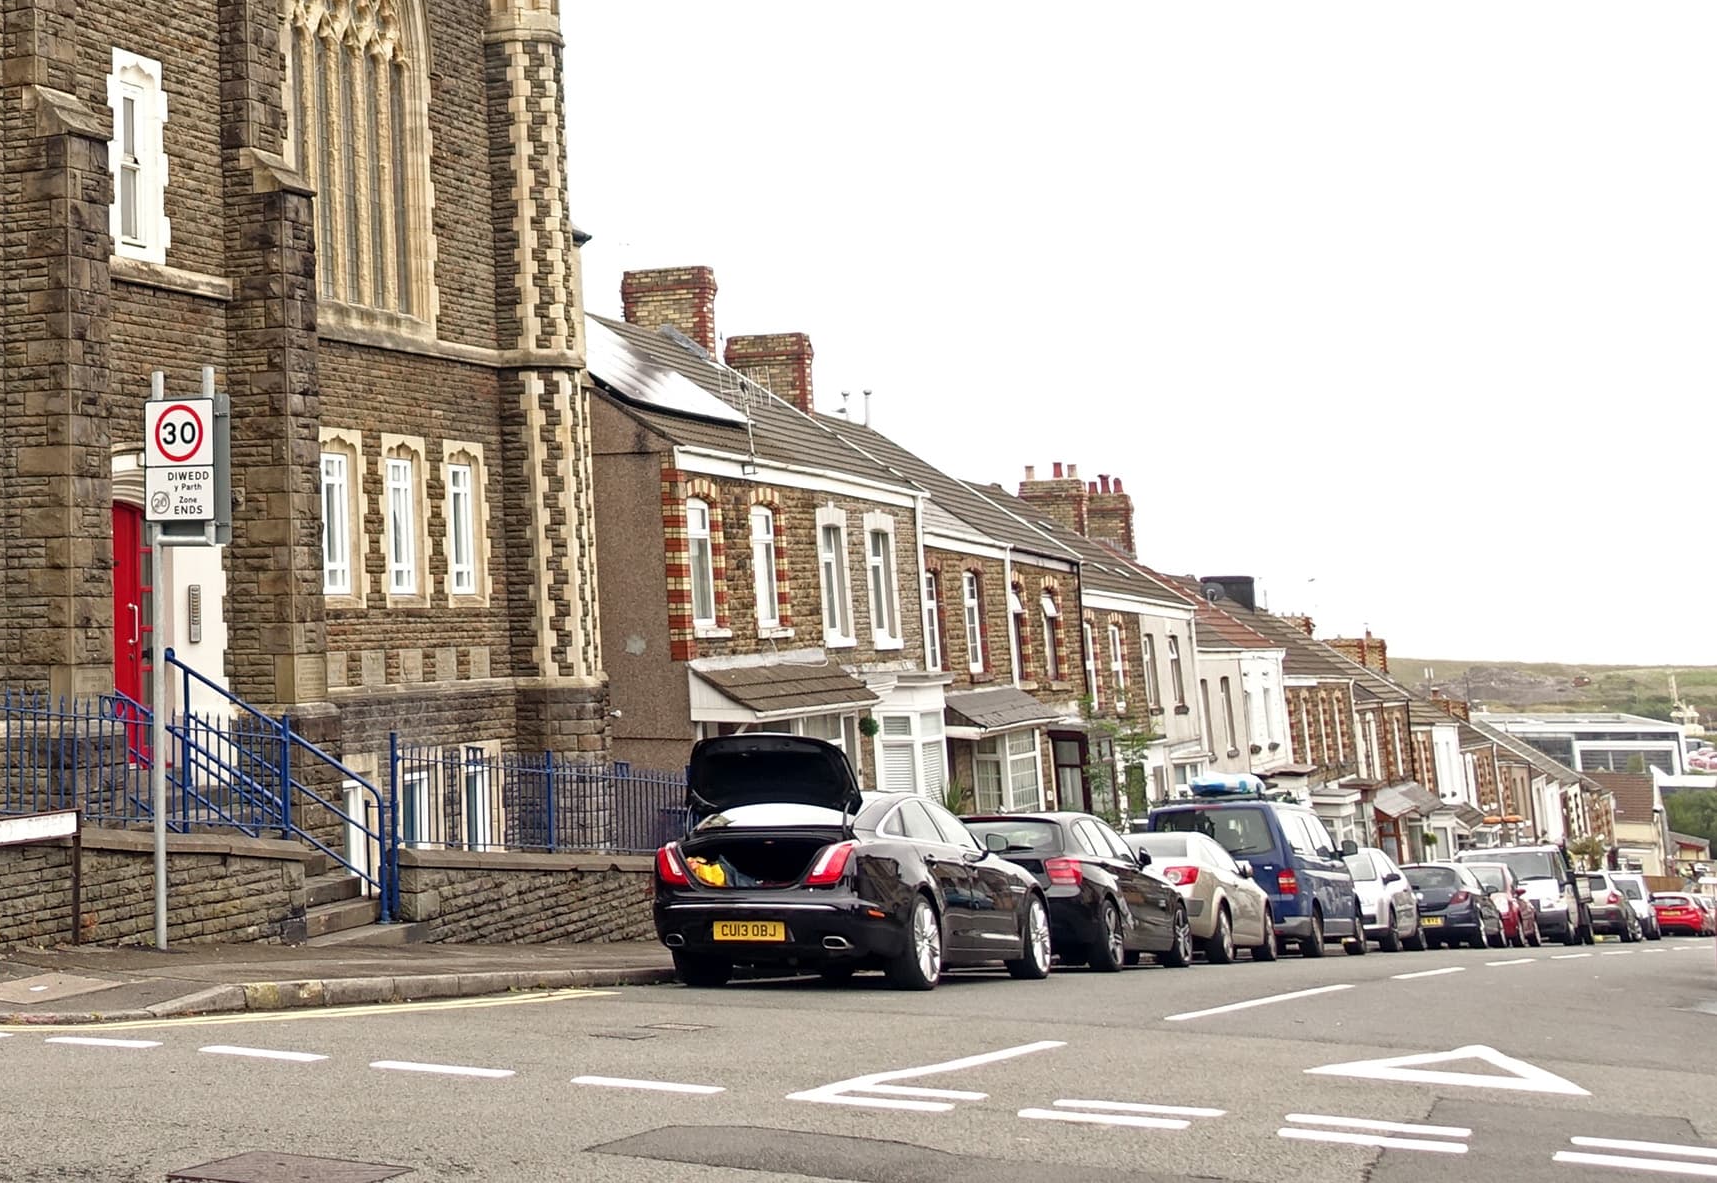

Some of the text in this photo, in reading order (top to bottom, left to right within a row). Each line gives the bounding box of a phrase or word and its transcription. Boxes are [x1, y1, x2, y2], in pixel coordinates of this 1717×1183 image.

[162, 421, 196, 445] 30
[167, 471, 209, 481] DIWEDD
[181, 483, 202, 491] Parth
[154, 498, 167, 508] 20
[179, 496, 197, 504] Zone
[174, 505, 203, 515] ENDS
[721, 924, 777, 937] CU13 OBJ
